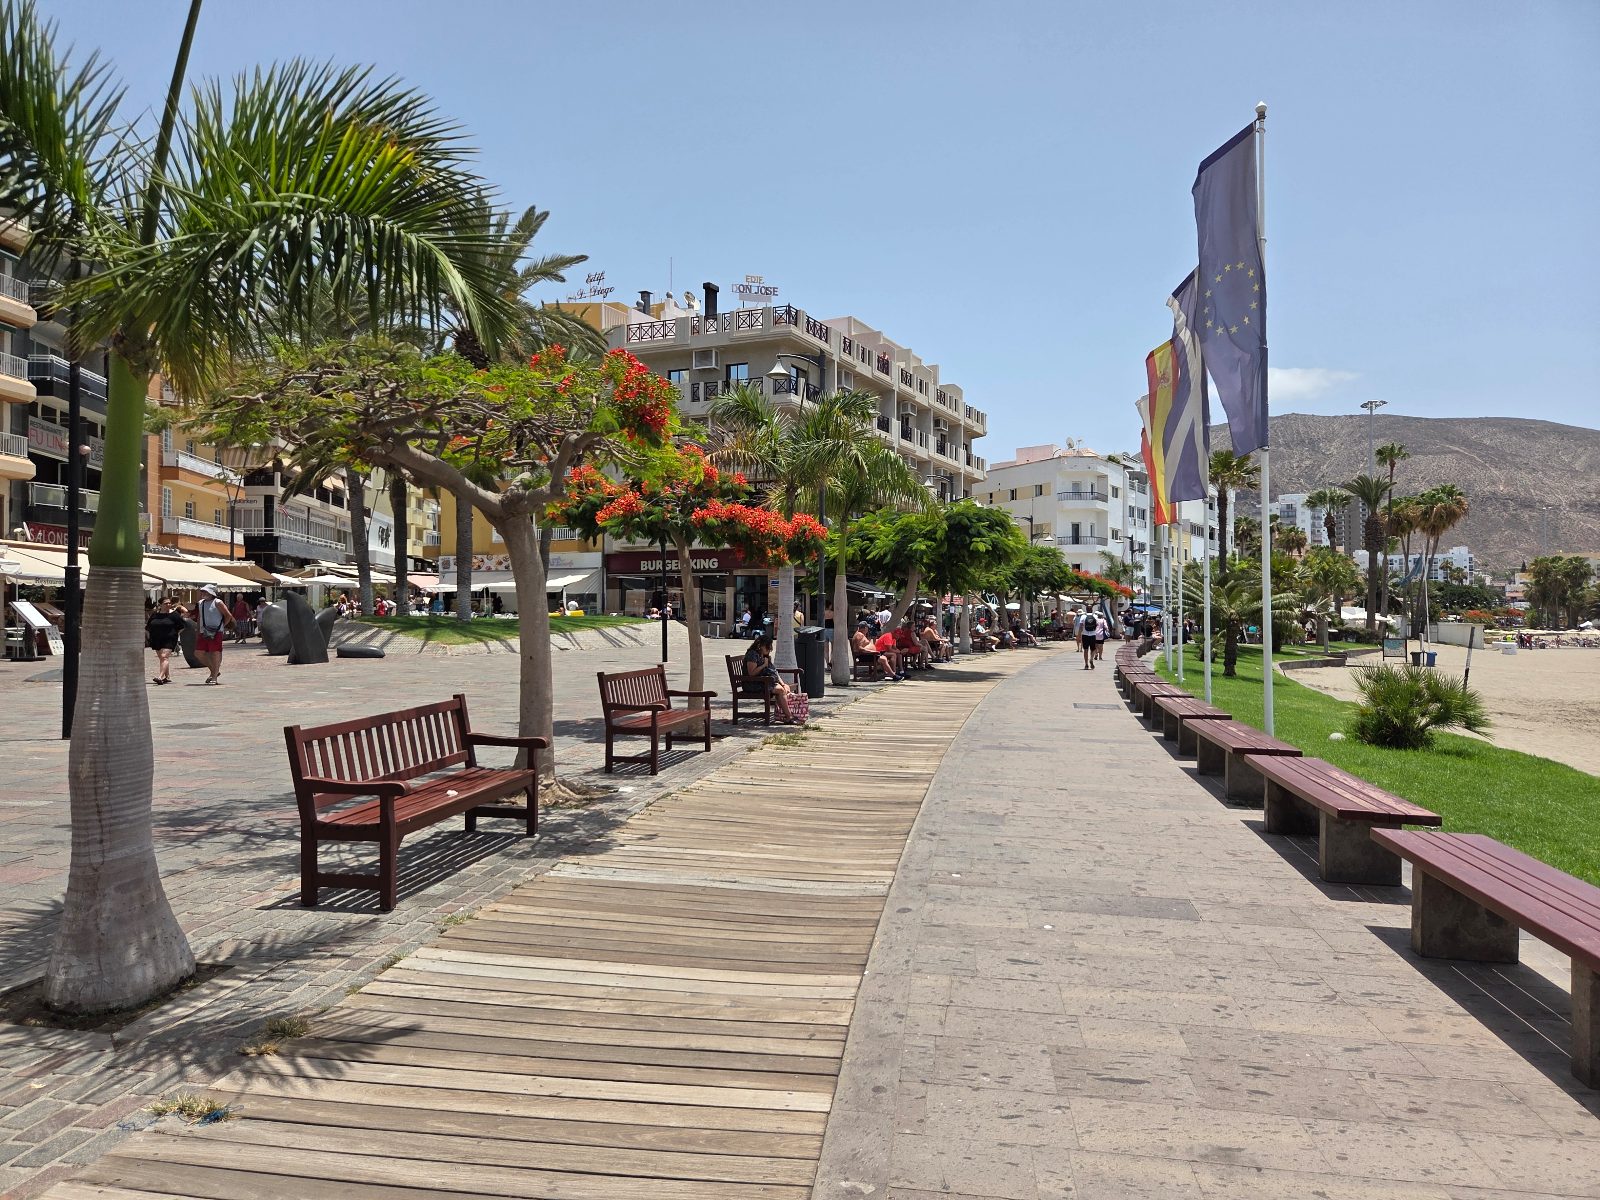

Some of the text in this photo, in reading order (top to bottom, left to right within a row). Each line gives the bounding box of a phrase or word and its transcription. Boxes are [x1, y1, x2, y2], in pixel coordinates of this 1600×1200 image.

[731, 283, 779, 297] DON JOSE
[29, 427, 44, 445] FU
[690, 557, 719, 570] KING
